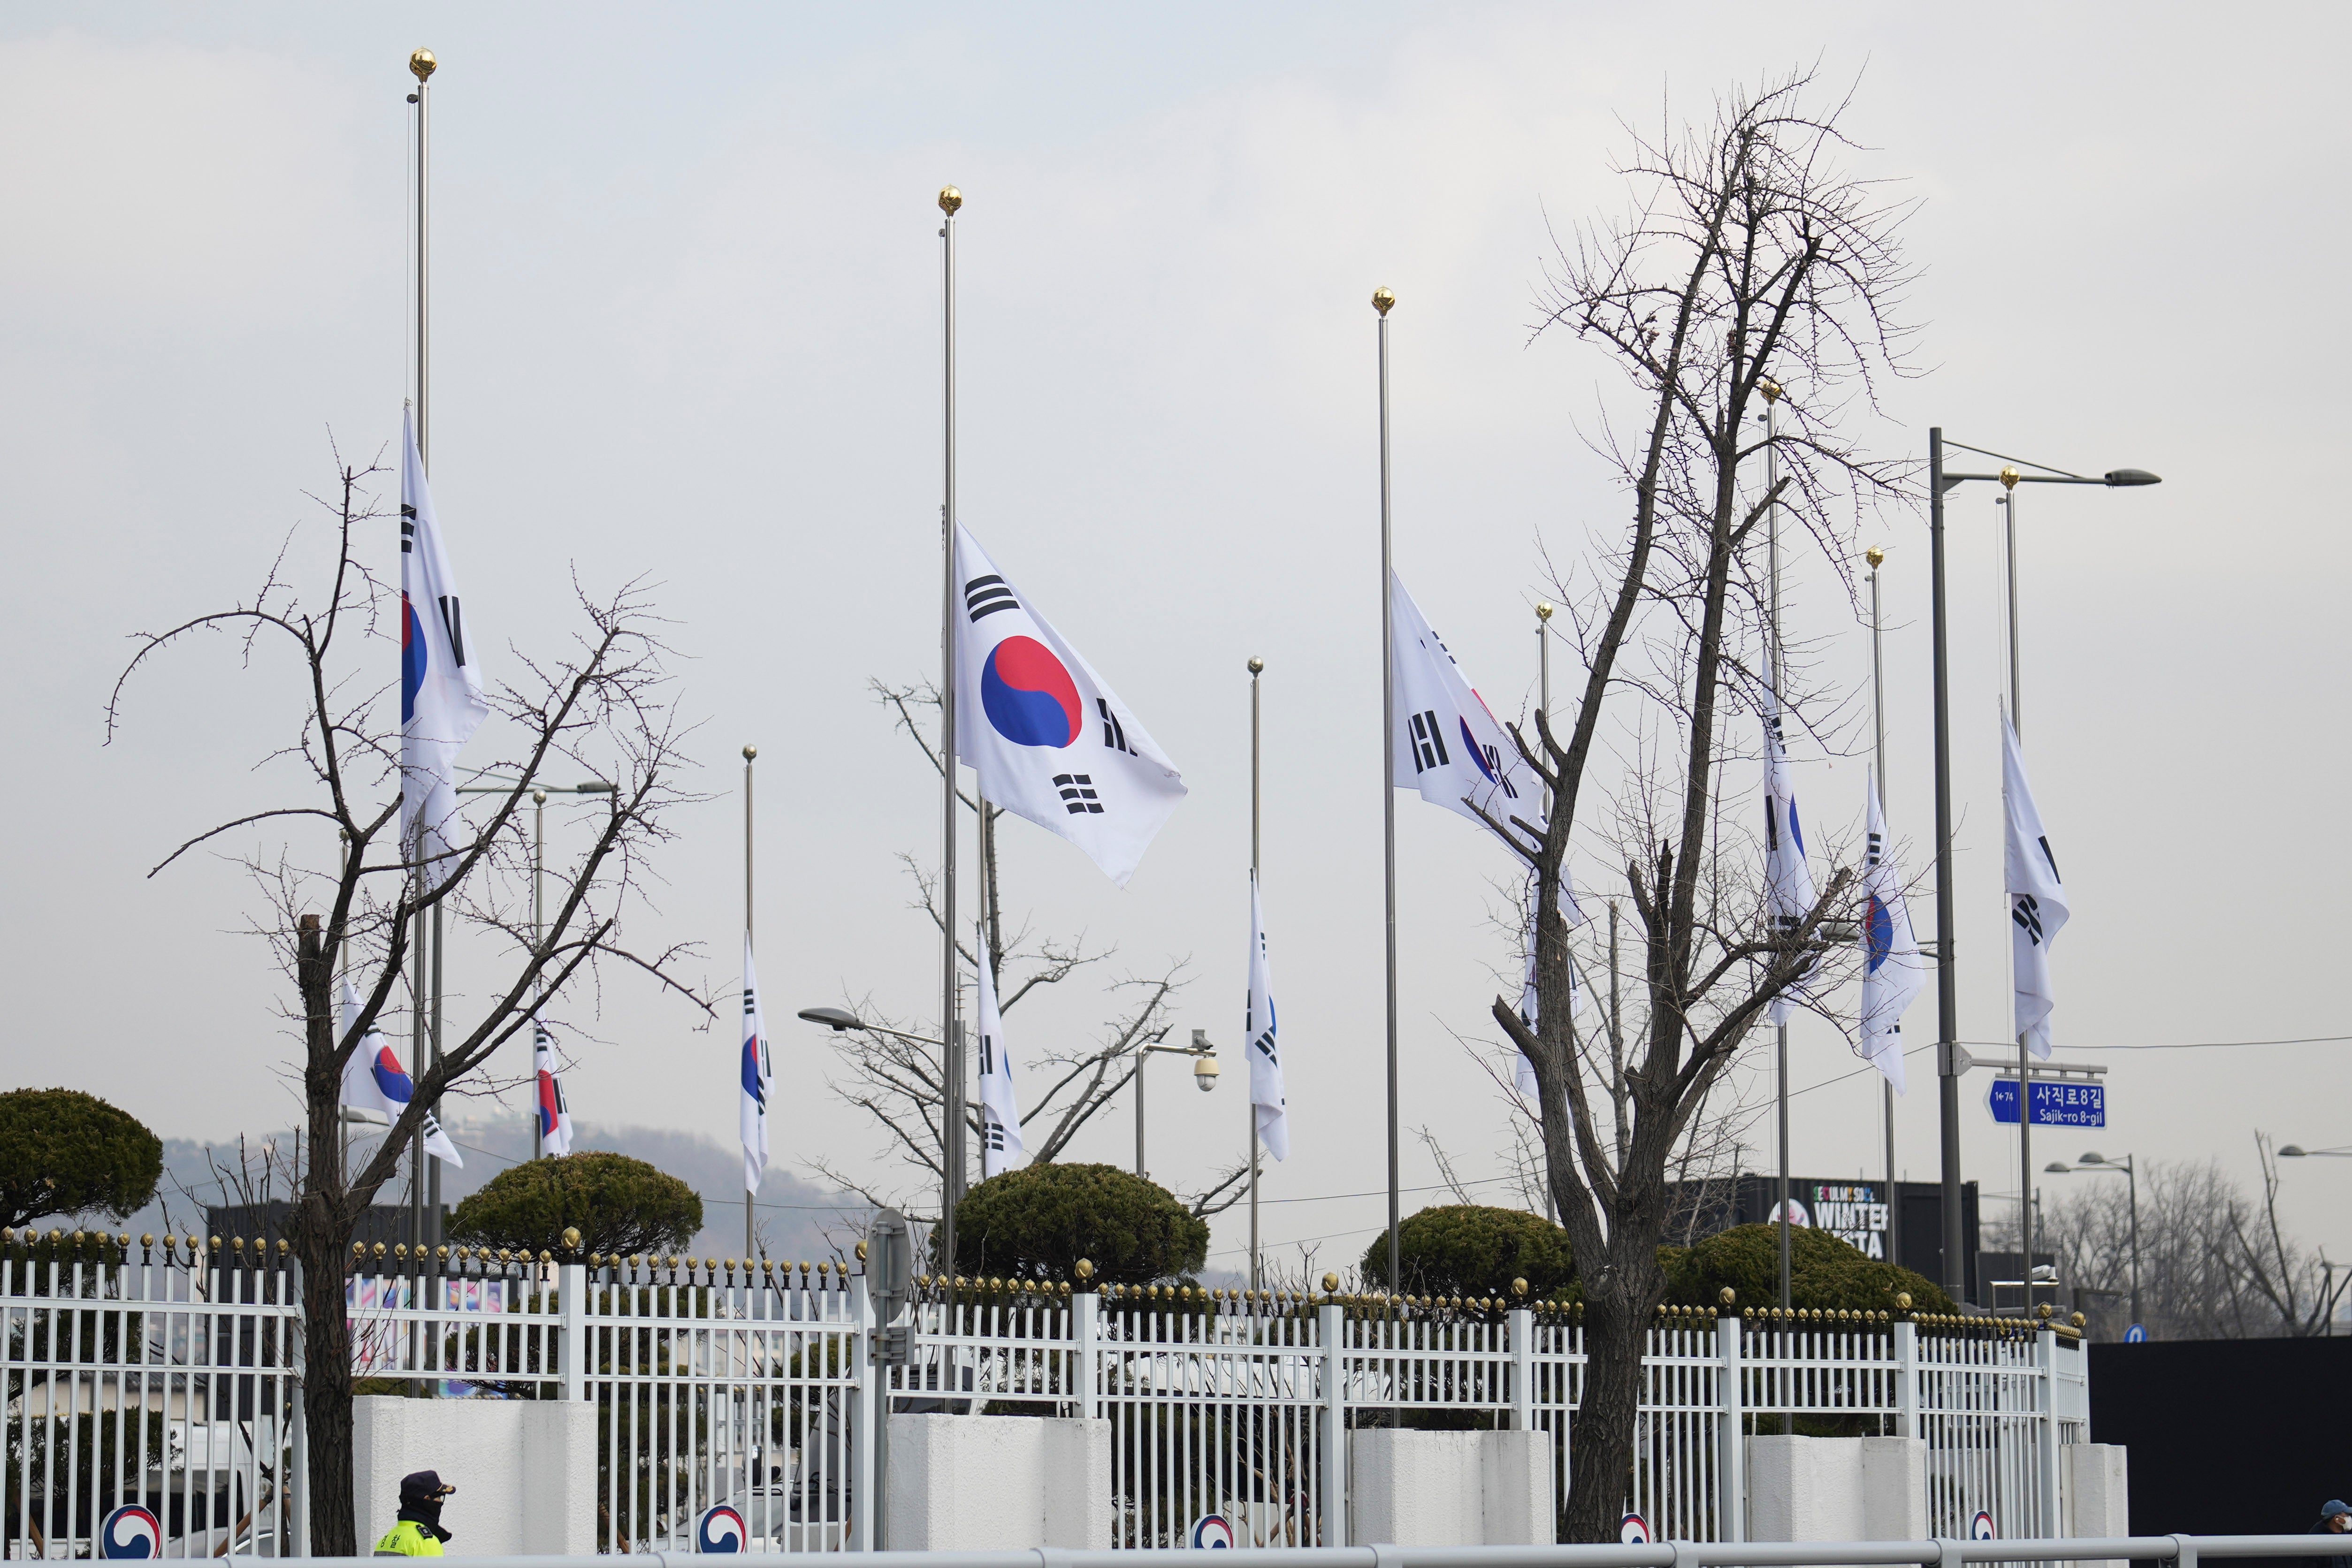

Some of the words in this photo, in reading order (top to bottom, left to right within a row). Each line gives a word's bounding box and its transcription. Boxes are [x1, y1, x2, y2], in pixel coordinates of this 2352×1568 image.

[2037, 1085, 2102, 1109] 사직로8길
[2040, 1109, 2078, 1124] Sajik-ro
[2080, 1111, 2102, 1126] 8-gil
